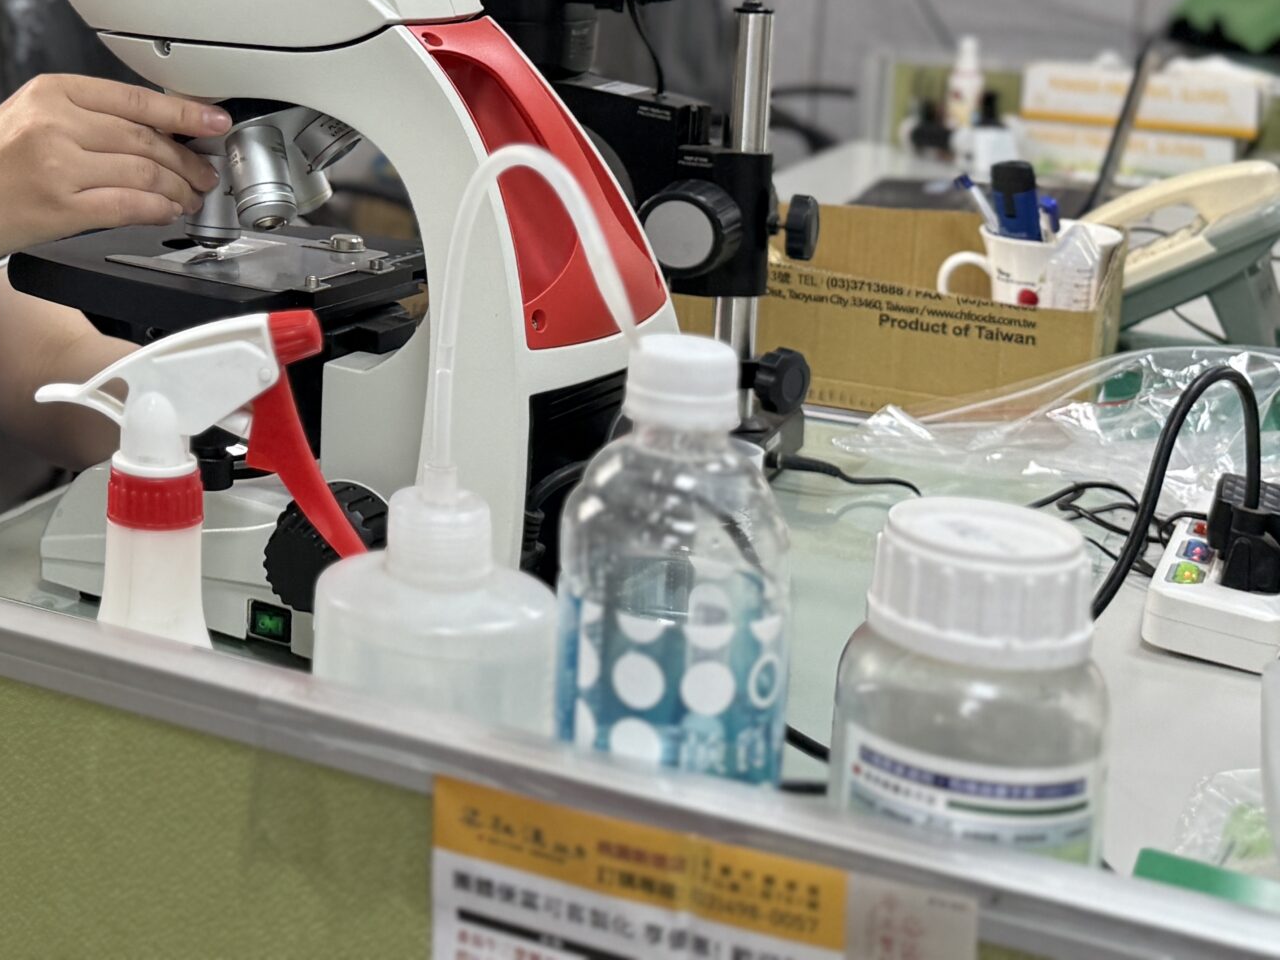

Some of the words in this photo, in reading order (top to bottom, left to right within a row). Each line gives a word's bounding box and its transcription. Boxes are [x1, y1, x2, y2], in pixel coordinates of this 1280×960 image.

[830, 294, 848, 307] City
[878, 313, 947, 335] Product
[953, 323, 971, 337] of
[976, 325, 1037, 346] Taiwan
